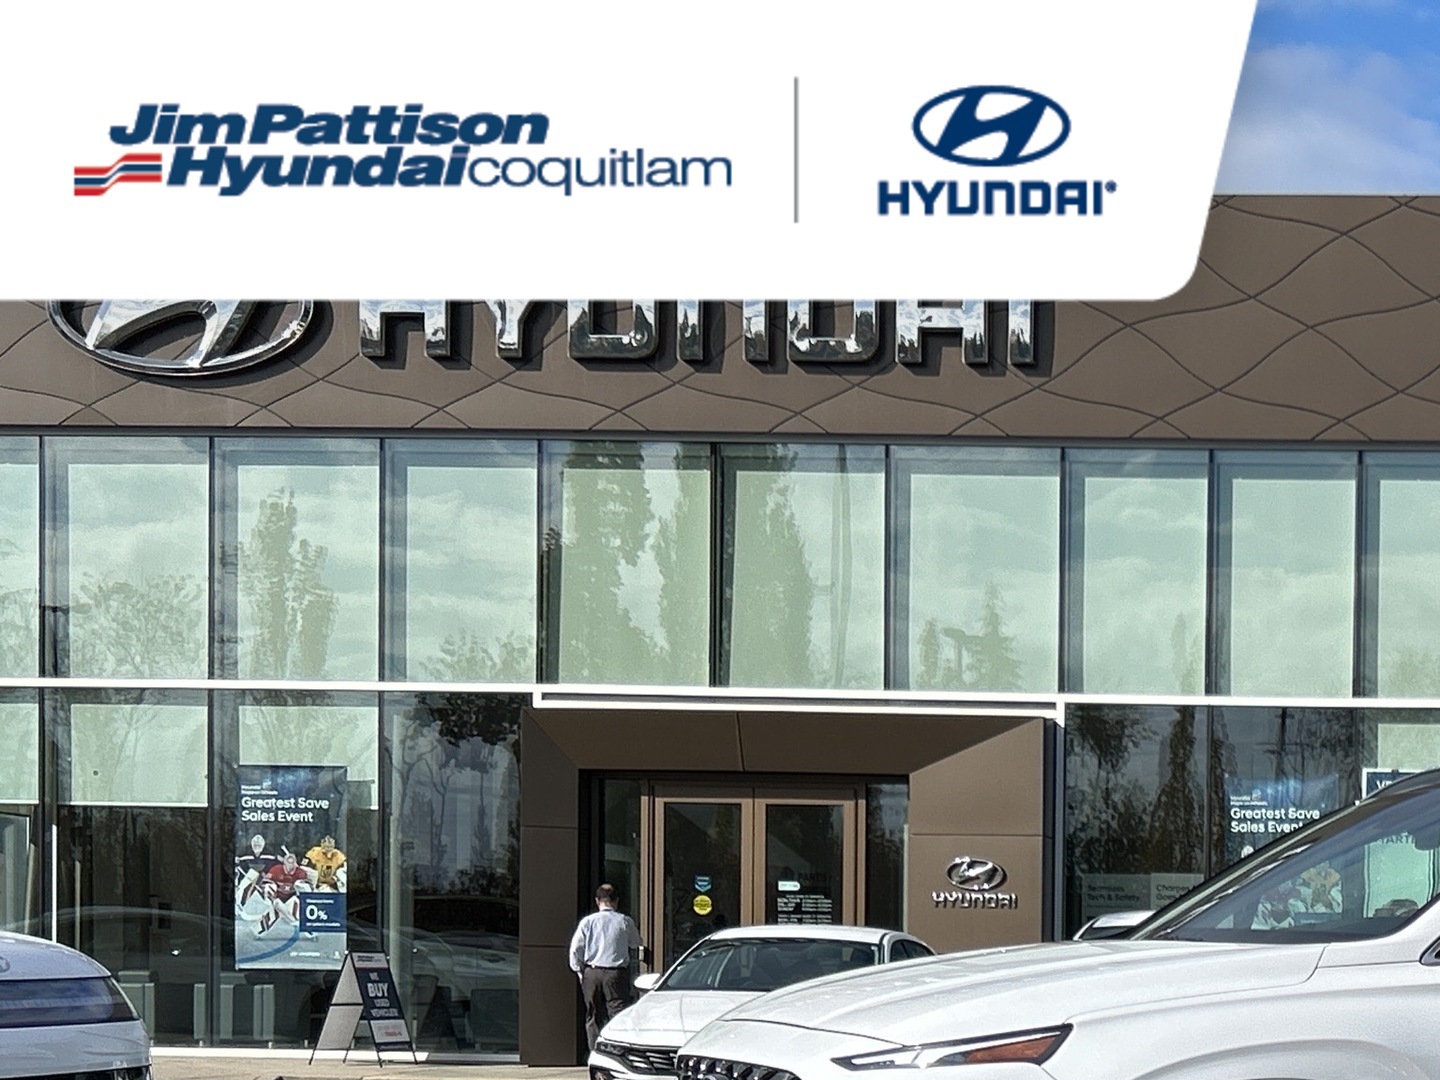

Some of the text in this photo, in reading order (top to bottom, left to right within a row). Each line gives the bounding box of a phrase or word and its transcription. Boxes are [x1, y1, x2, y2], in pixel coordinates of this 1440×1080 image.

[241, 796, 329, 809] Greatest Save
[241, 810, 313, 822] Sales Event
[1230, 808, 1320, 819] Greatest Save
[1230, 821, 1265, 833] Sales
[932, 891, 1018, 909] HYUNDAI
[305, 904, 328, 920] 0%
[366, 982, 388, 997] BUY
